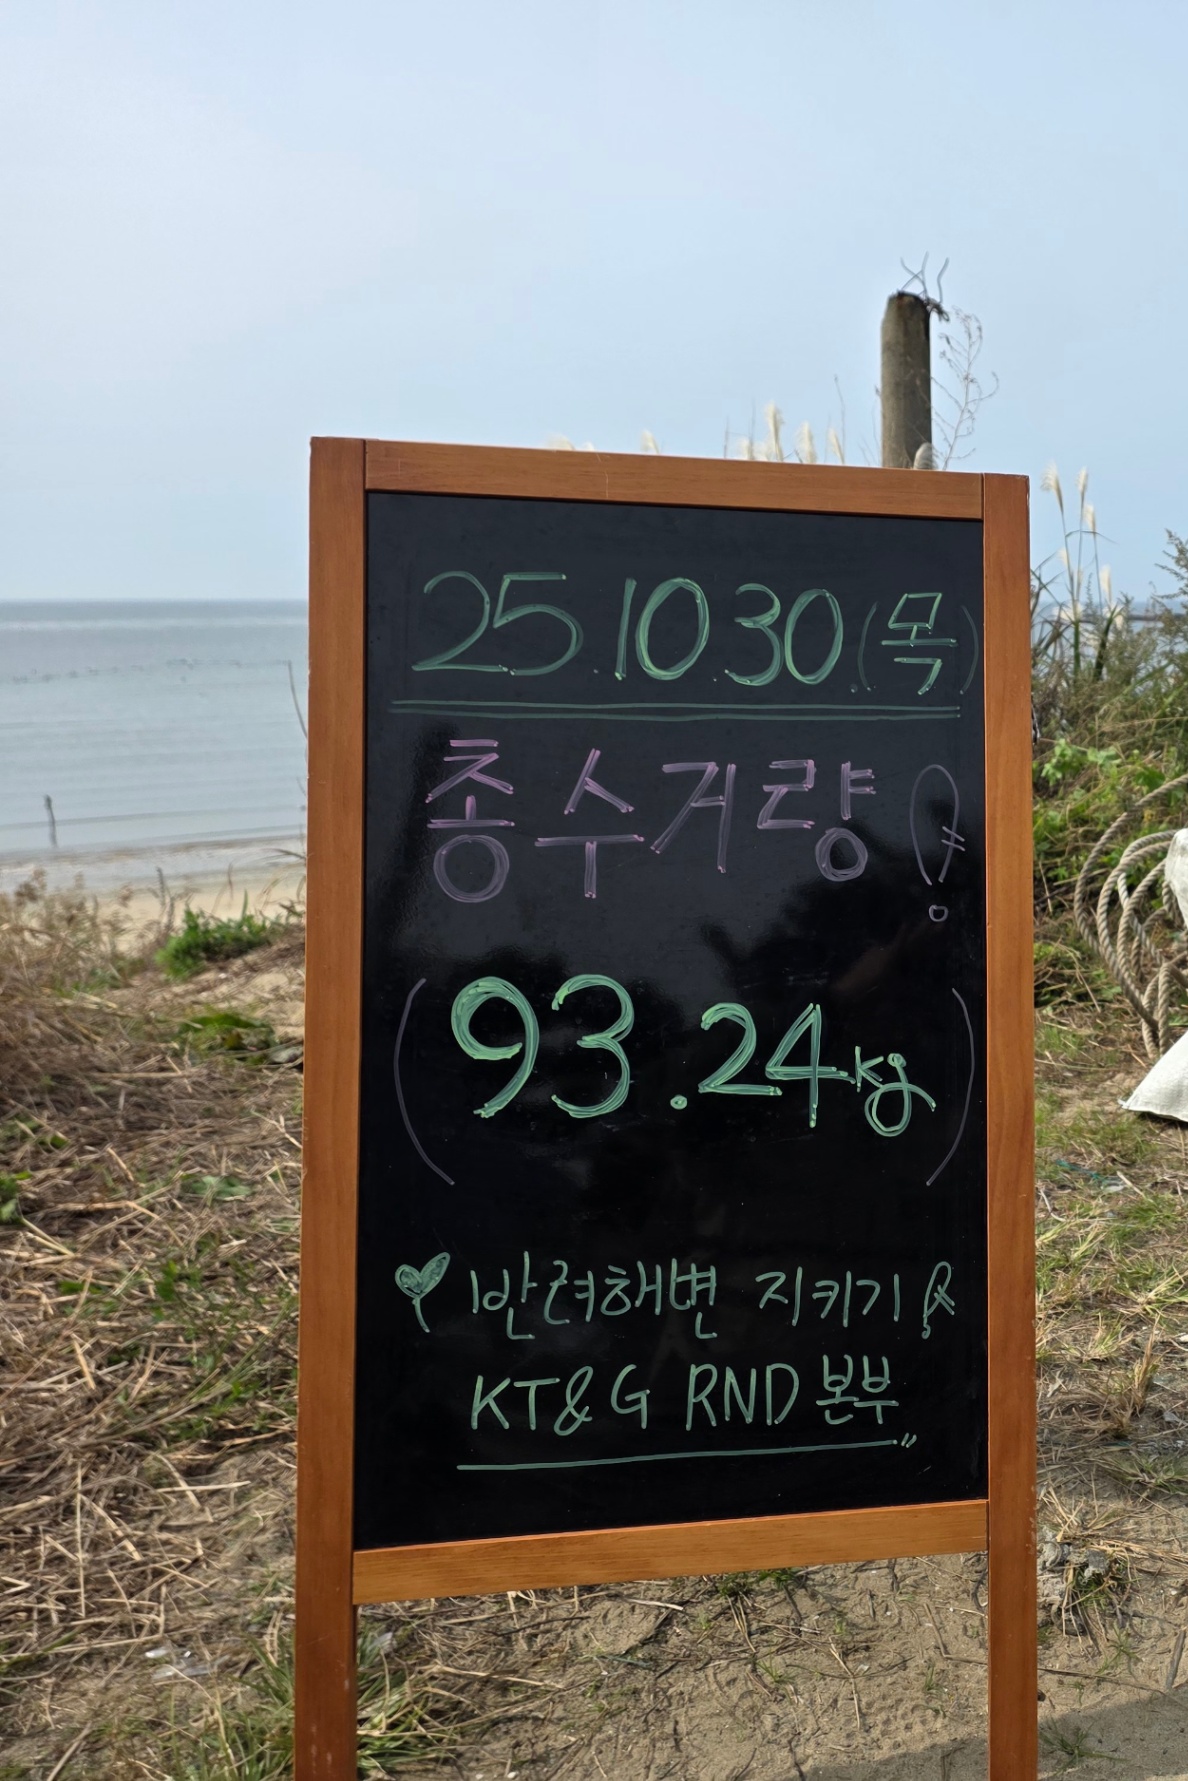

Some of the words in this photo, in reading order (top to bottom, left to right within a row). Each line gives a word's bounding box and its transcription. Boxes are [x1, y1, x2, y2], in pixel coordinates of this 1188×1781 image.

[469, 1250, 718, 1340] 반려해변
[469, 1364, 651, 1436] KT&G
[685, 1363, 800, 1431] RND
